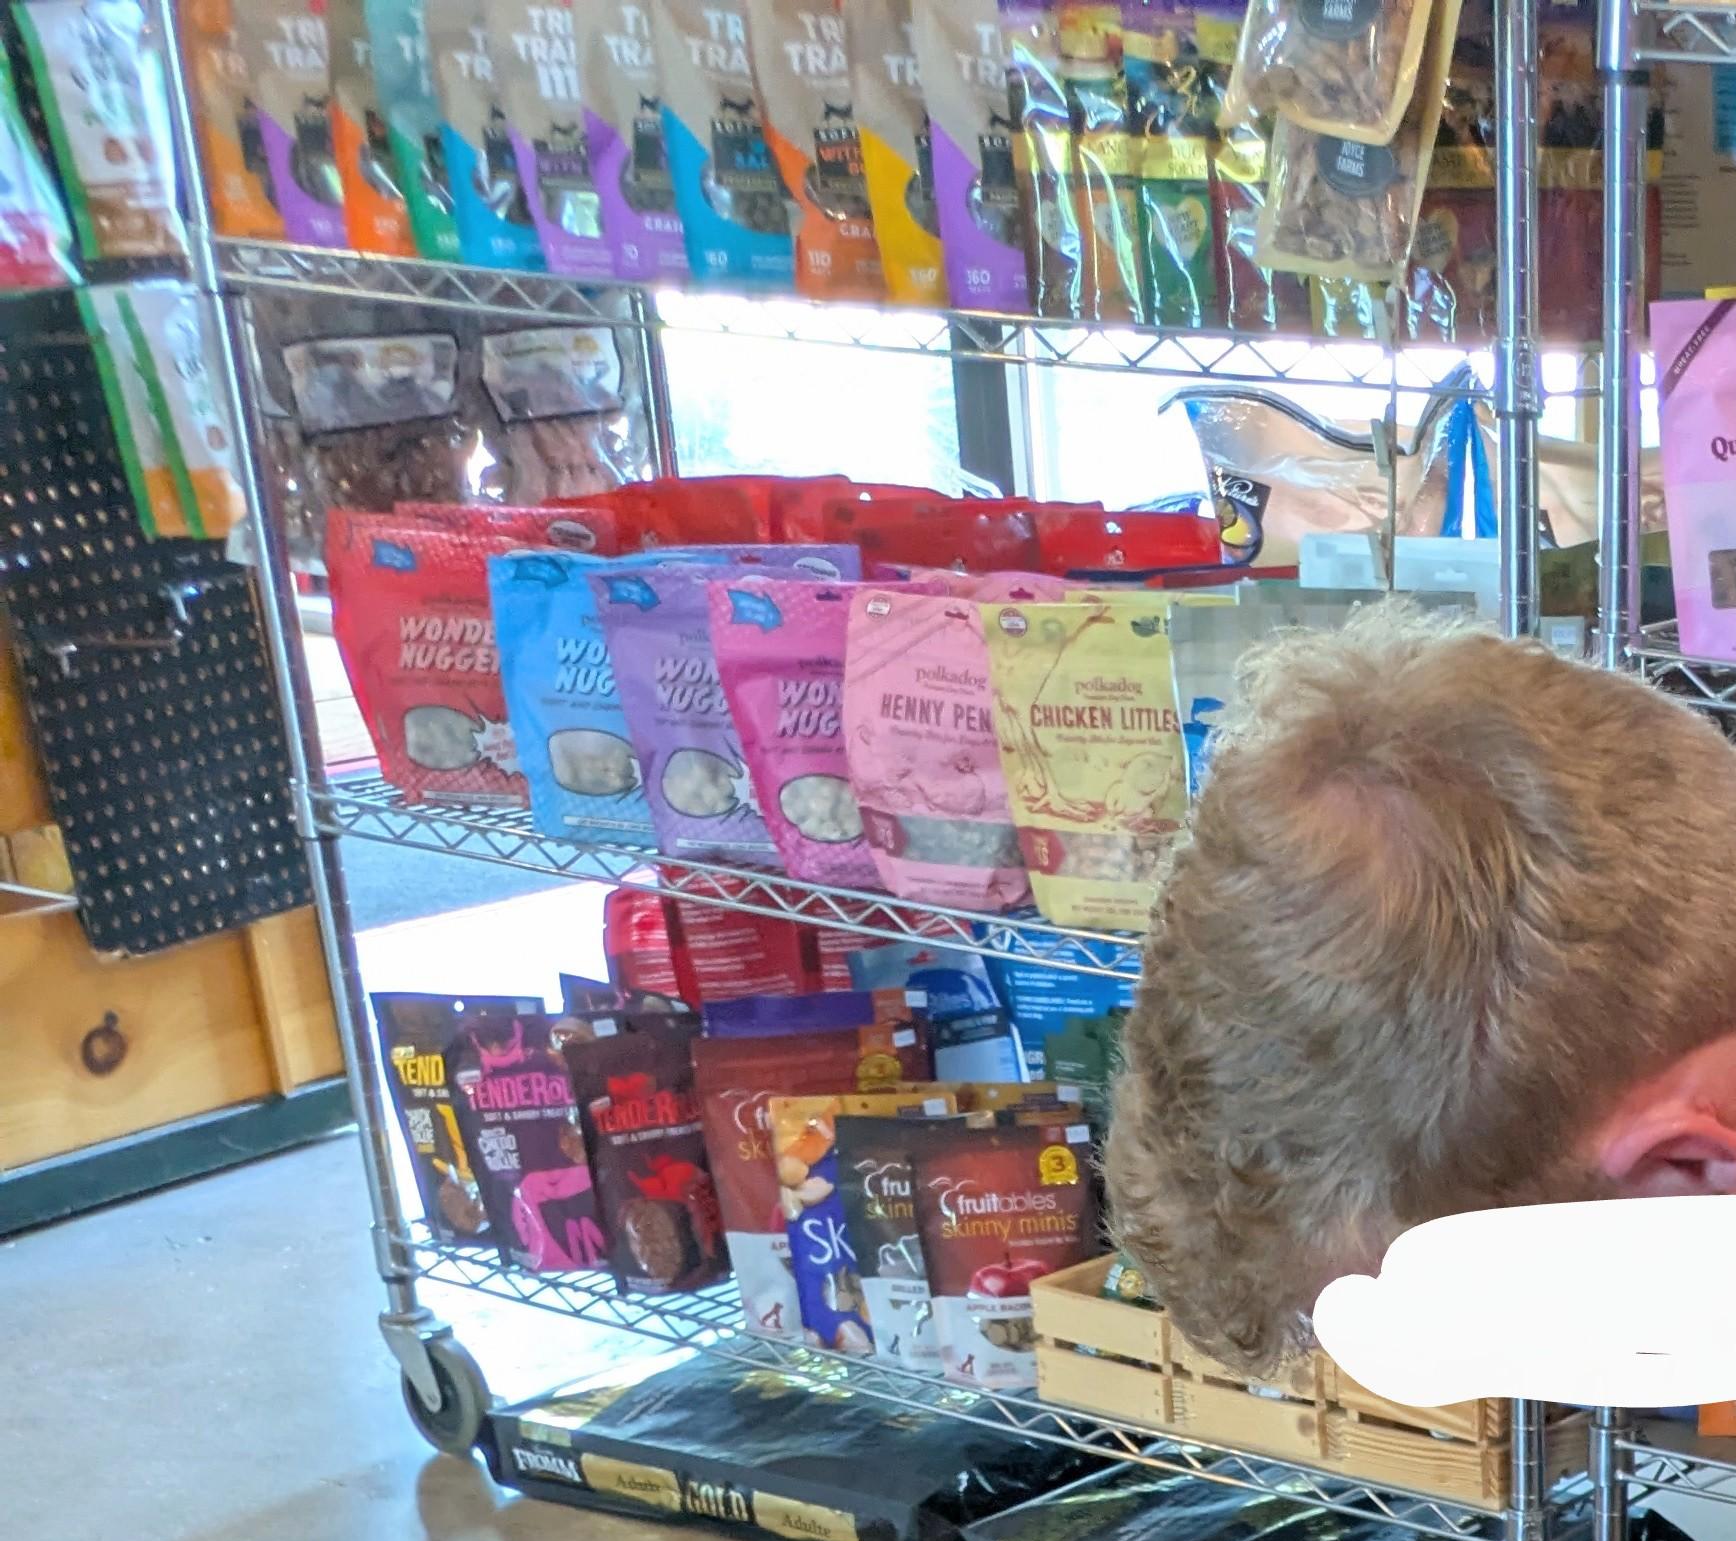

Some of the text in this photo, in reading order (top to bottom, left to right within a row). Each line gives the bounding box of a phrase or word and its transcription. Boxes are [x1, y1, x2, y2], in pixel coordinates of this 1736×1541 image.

[1325, 155, 1365, 178] FARMS
[399, 615, 496, 647] WONDE
[398, 643, 500, 675] NUGGE
[914, 664, 988, 692] polkadog
[1074, 675, 1144, 696] polkadog
[776, 678, 844, 710] WON
[880, 692, 992, 733] HENNY PEN
[1029, 703, 1113, 730] CHICKEN
[1051, 1154, 1066, 1173] 3
[956, 1188, 1057, 1216] fruitables
[941, 1206, 1079, 1245] skinny minis
[511, 1447, 584, 1483] FROMM
